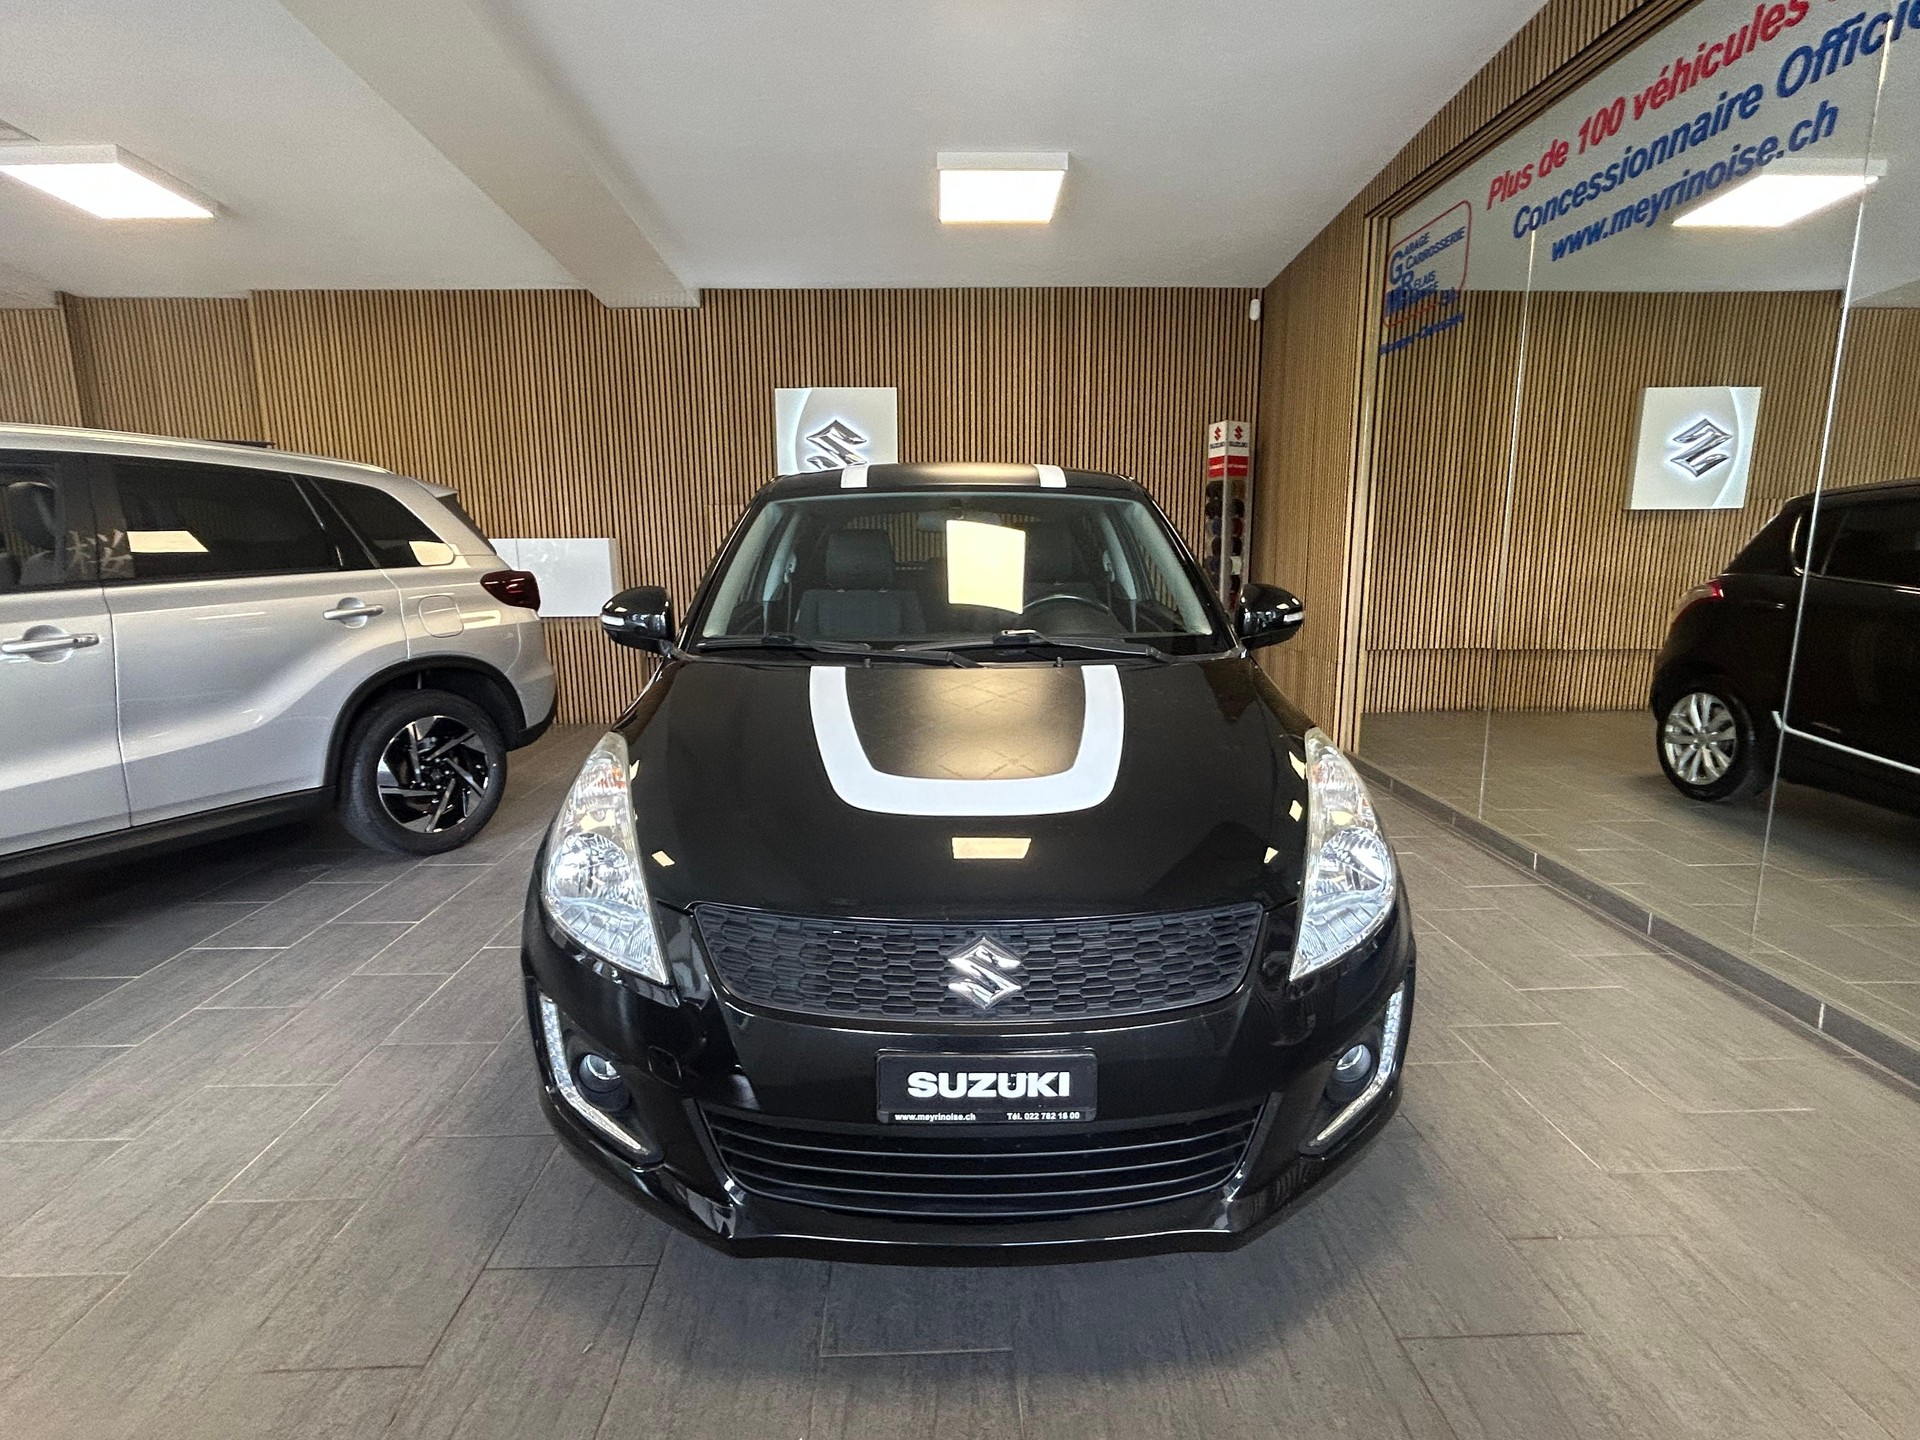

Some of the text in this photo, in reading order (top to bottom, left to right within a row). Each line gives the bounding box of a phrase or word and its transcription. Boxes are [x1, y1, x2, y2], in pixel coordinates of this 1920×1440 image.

[1487, 0, 1809, 210] Plus de 100 véhicules
[1513, 84, 1763, 239] Concessionnaire
[1551, 100, 1839, 262] www.meyrinoise.ch
[894, 1112, 977, 1122] www.meyrinoise.ch
[907, 1072, 1070, 1098] SUZUKI
[1024, 1112, 1040, 1120] 022
[1069, 1111, 1081, 1120] 00
